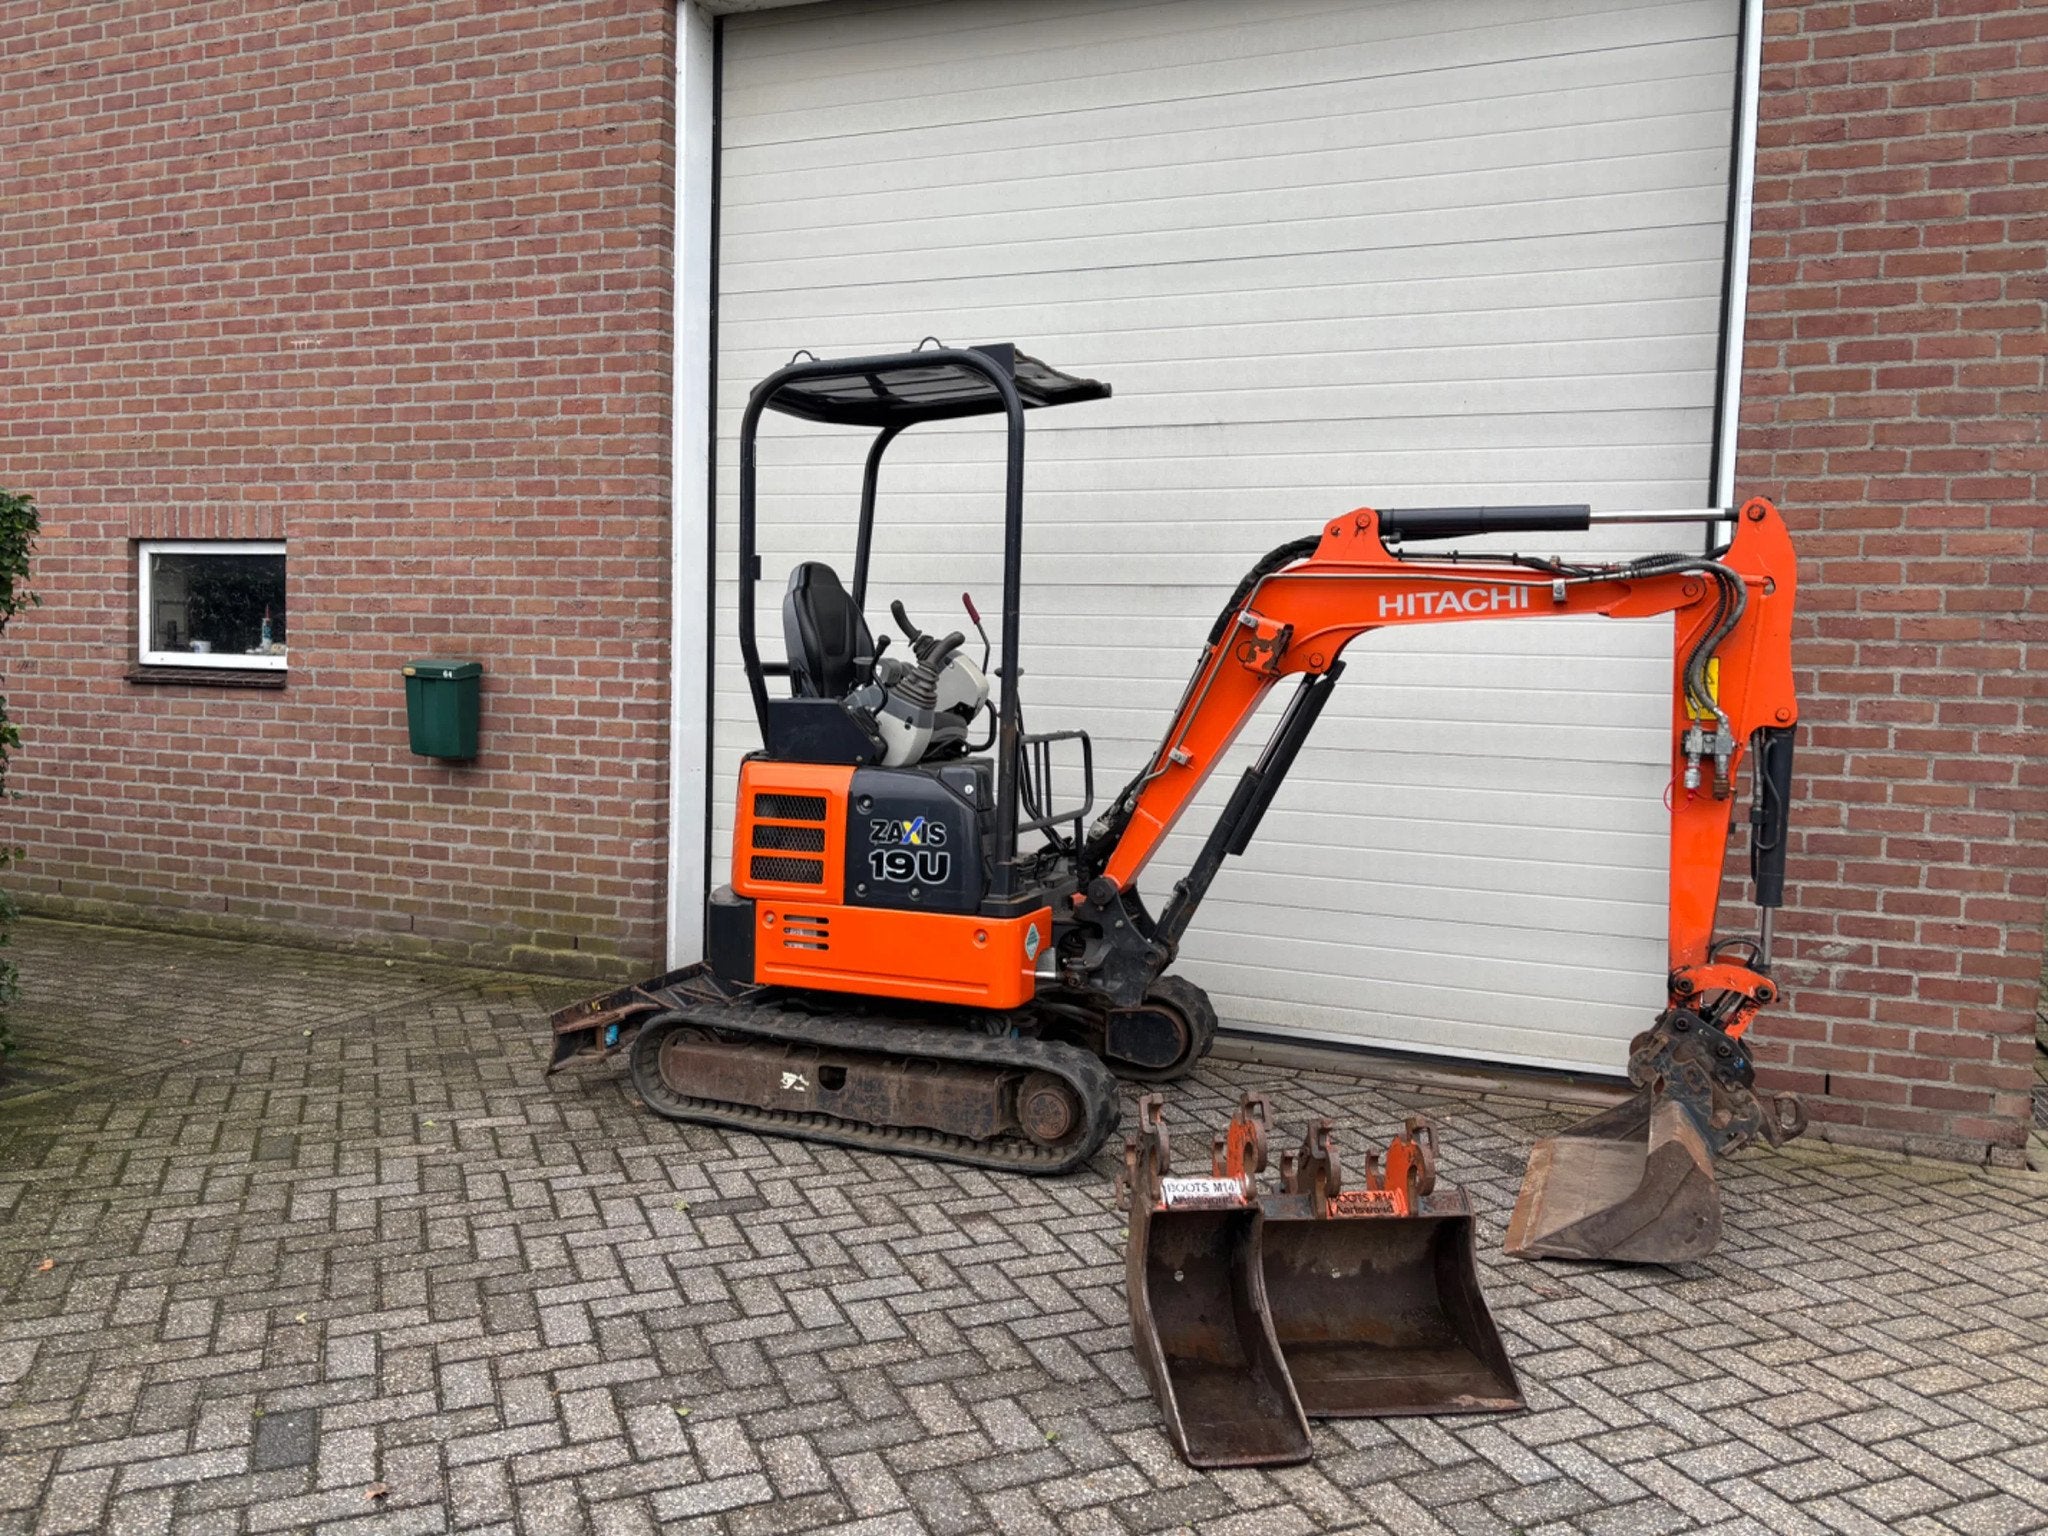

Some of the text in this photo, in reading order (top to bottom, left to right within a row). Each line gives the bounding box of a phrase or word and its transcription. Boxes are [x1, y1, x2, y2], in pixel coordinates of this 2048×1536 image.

[1378, 585, 1529, 617] HITACHI
[869, 816, 948, 847] ZAXIS
[868, 849, 950, 884] 19U
[1166, 1182, 1210, 1193] BOOTS
